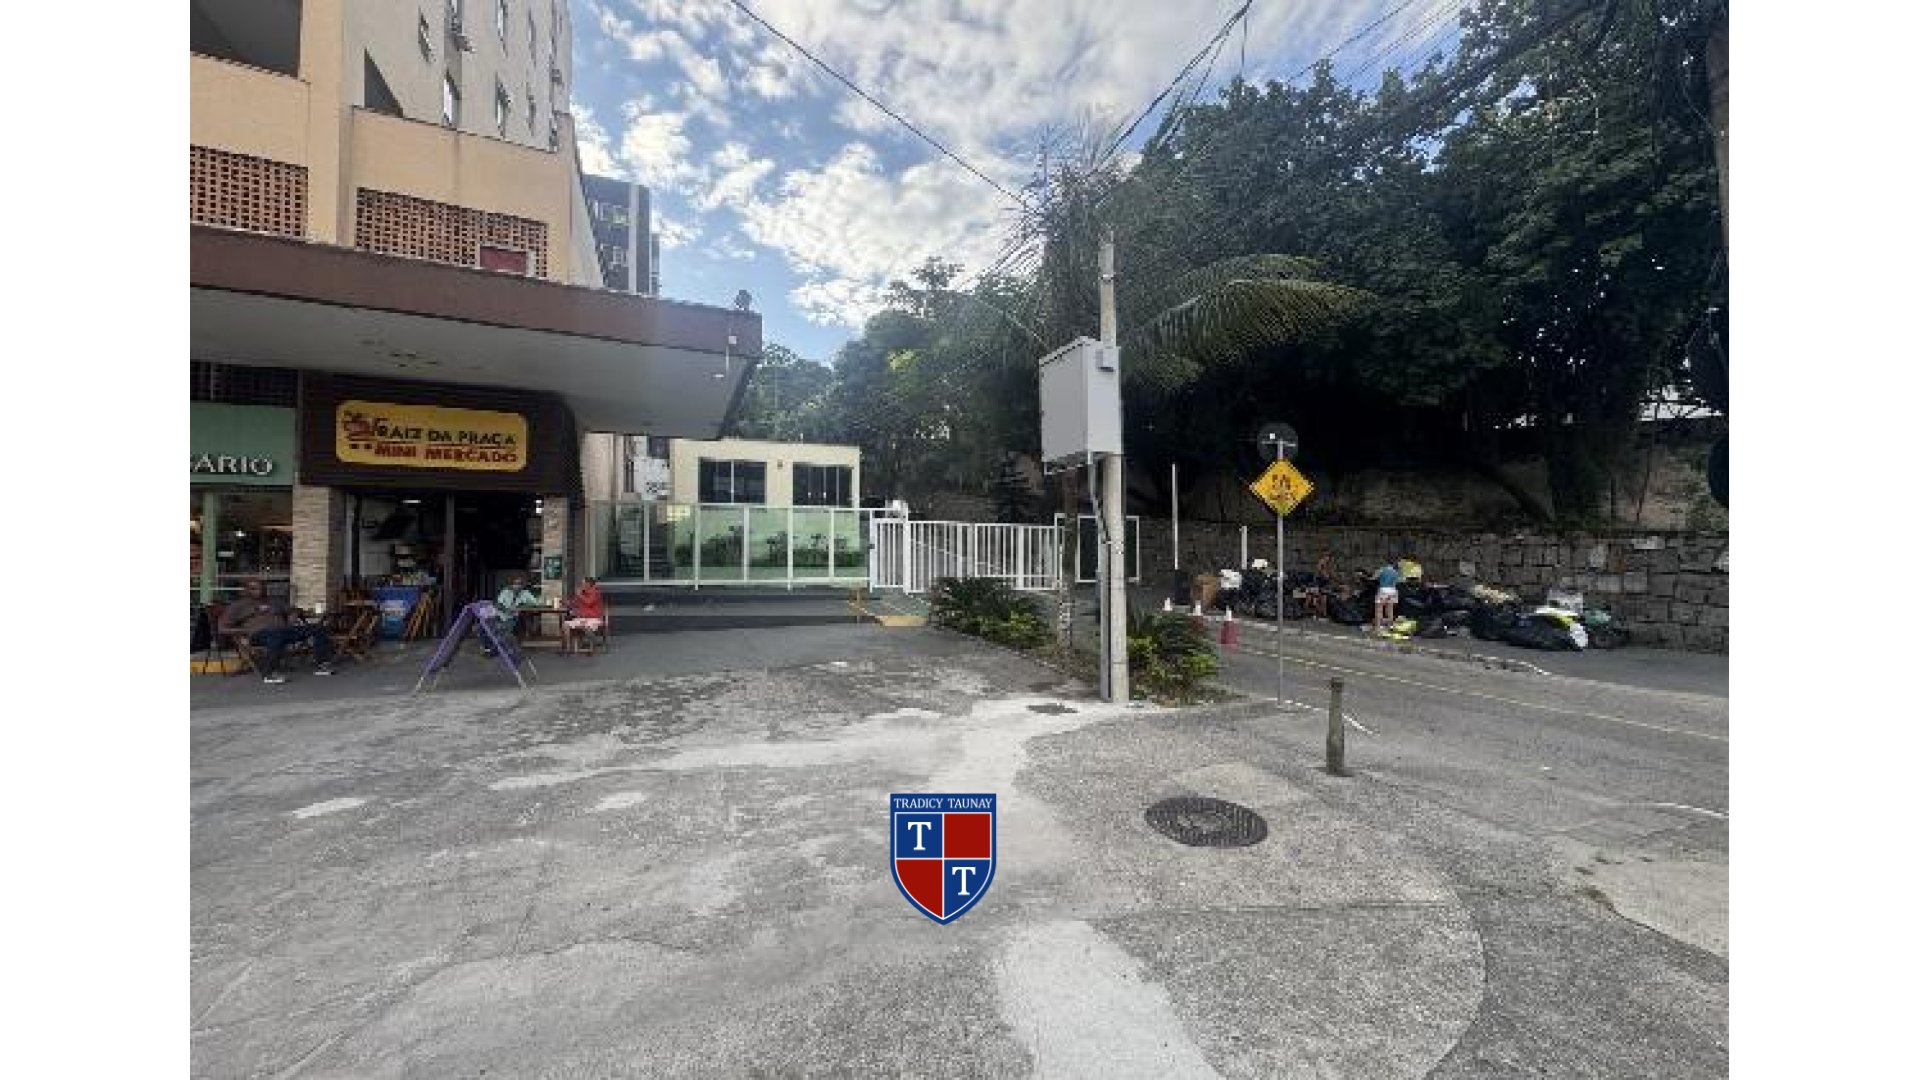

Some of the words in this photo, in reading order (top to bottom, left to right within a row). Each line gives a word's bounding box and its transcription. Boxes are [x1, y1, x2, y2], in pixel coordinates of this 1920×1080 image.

[375, 421, 423, 440] RAIZ
[427, 430, 452, 442] DA
[374, 446, 417, 458] MINI
[425, 448, 518, 463] MERCADO
